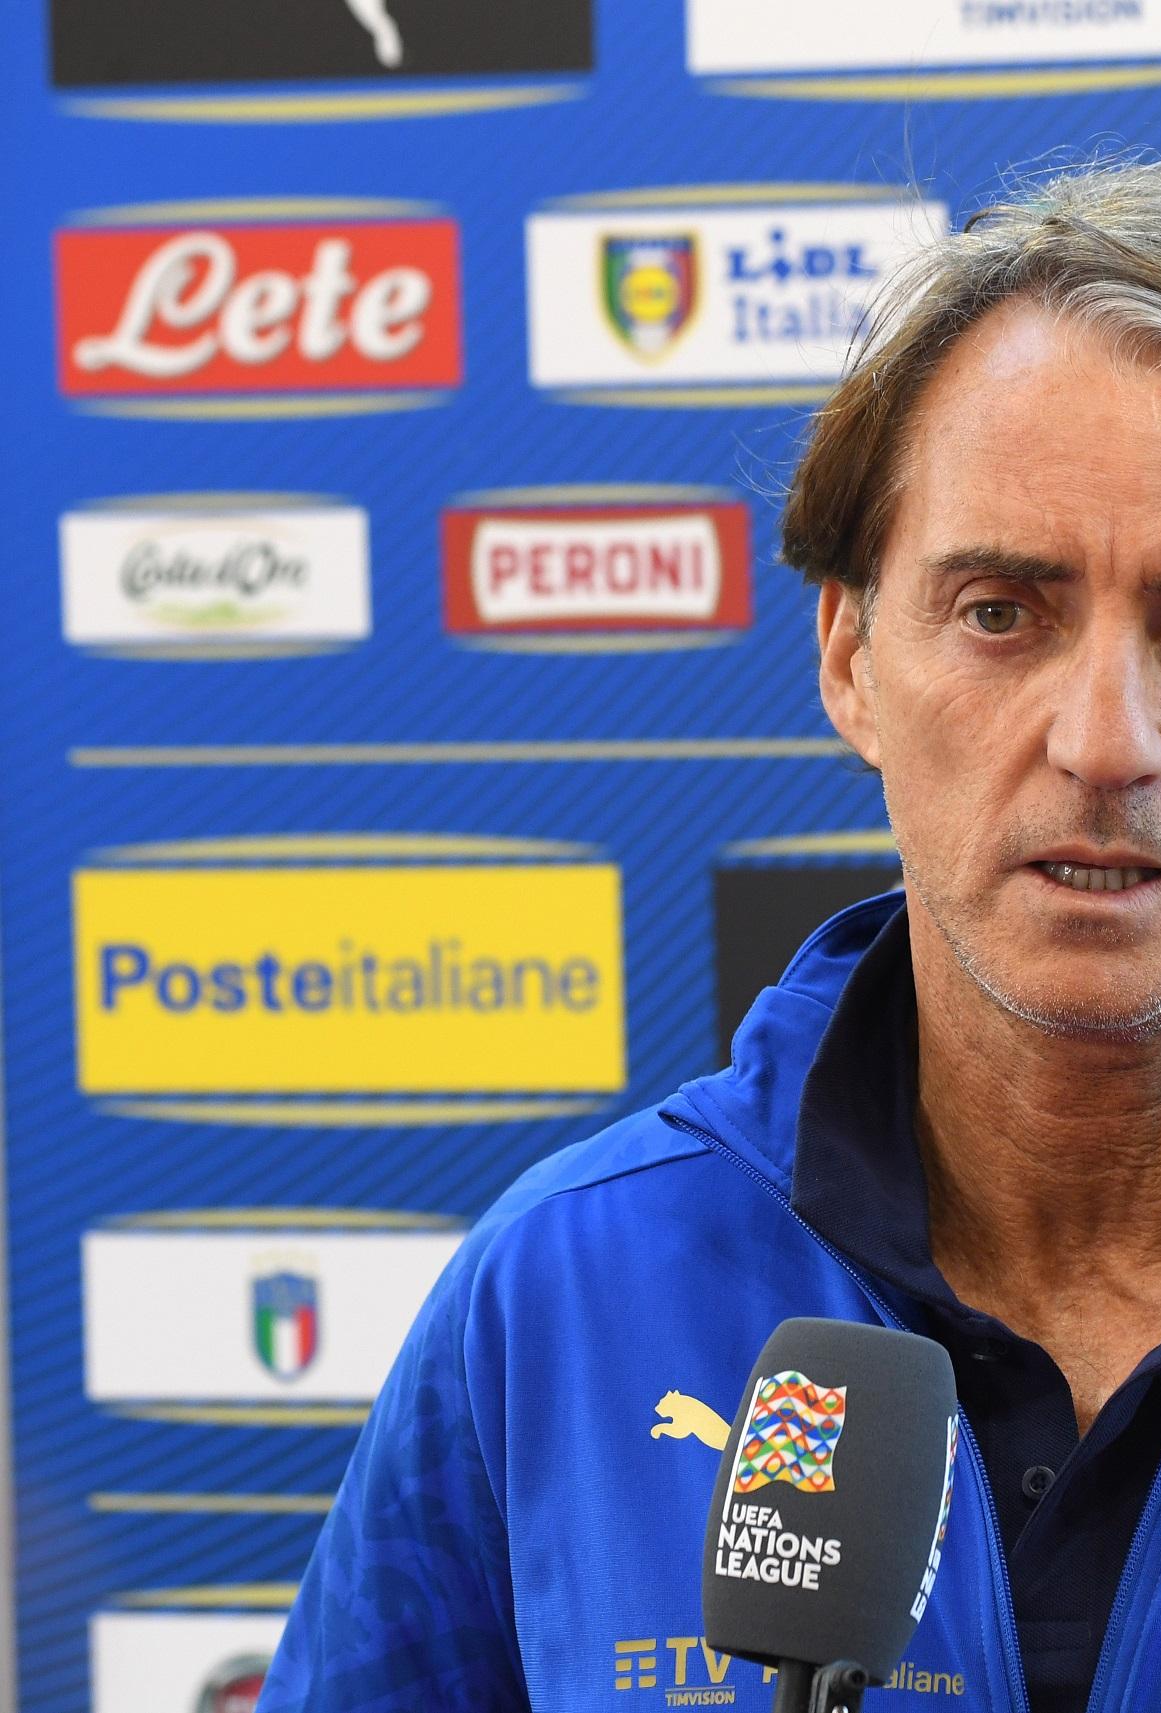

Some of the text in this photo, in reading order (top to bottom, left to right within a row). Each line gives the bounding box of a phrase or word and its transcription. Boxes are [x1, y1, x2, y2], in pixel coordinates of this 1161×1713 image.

[74, 232, 432, 377] Lete
[487, 542, 703, 596] PERONI
[731, 1503, 783, 1530] UEFA
[718, 1523, 842, 1566] NATIONS
[714, 1549, 822, 1591] LEAGUE
[666, 1637, 732, 1685] TV
[665, 1690, 735, 1707] TIMVISION
